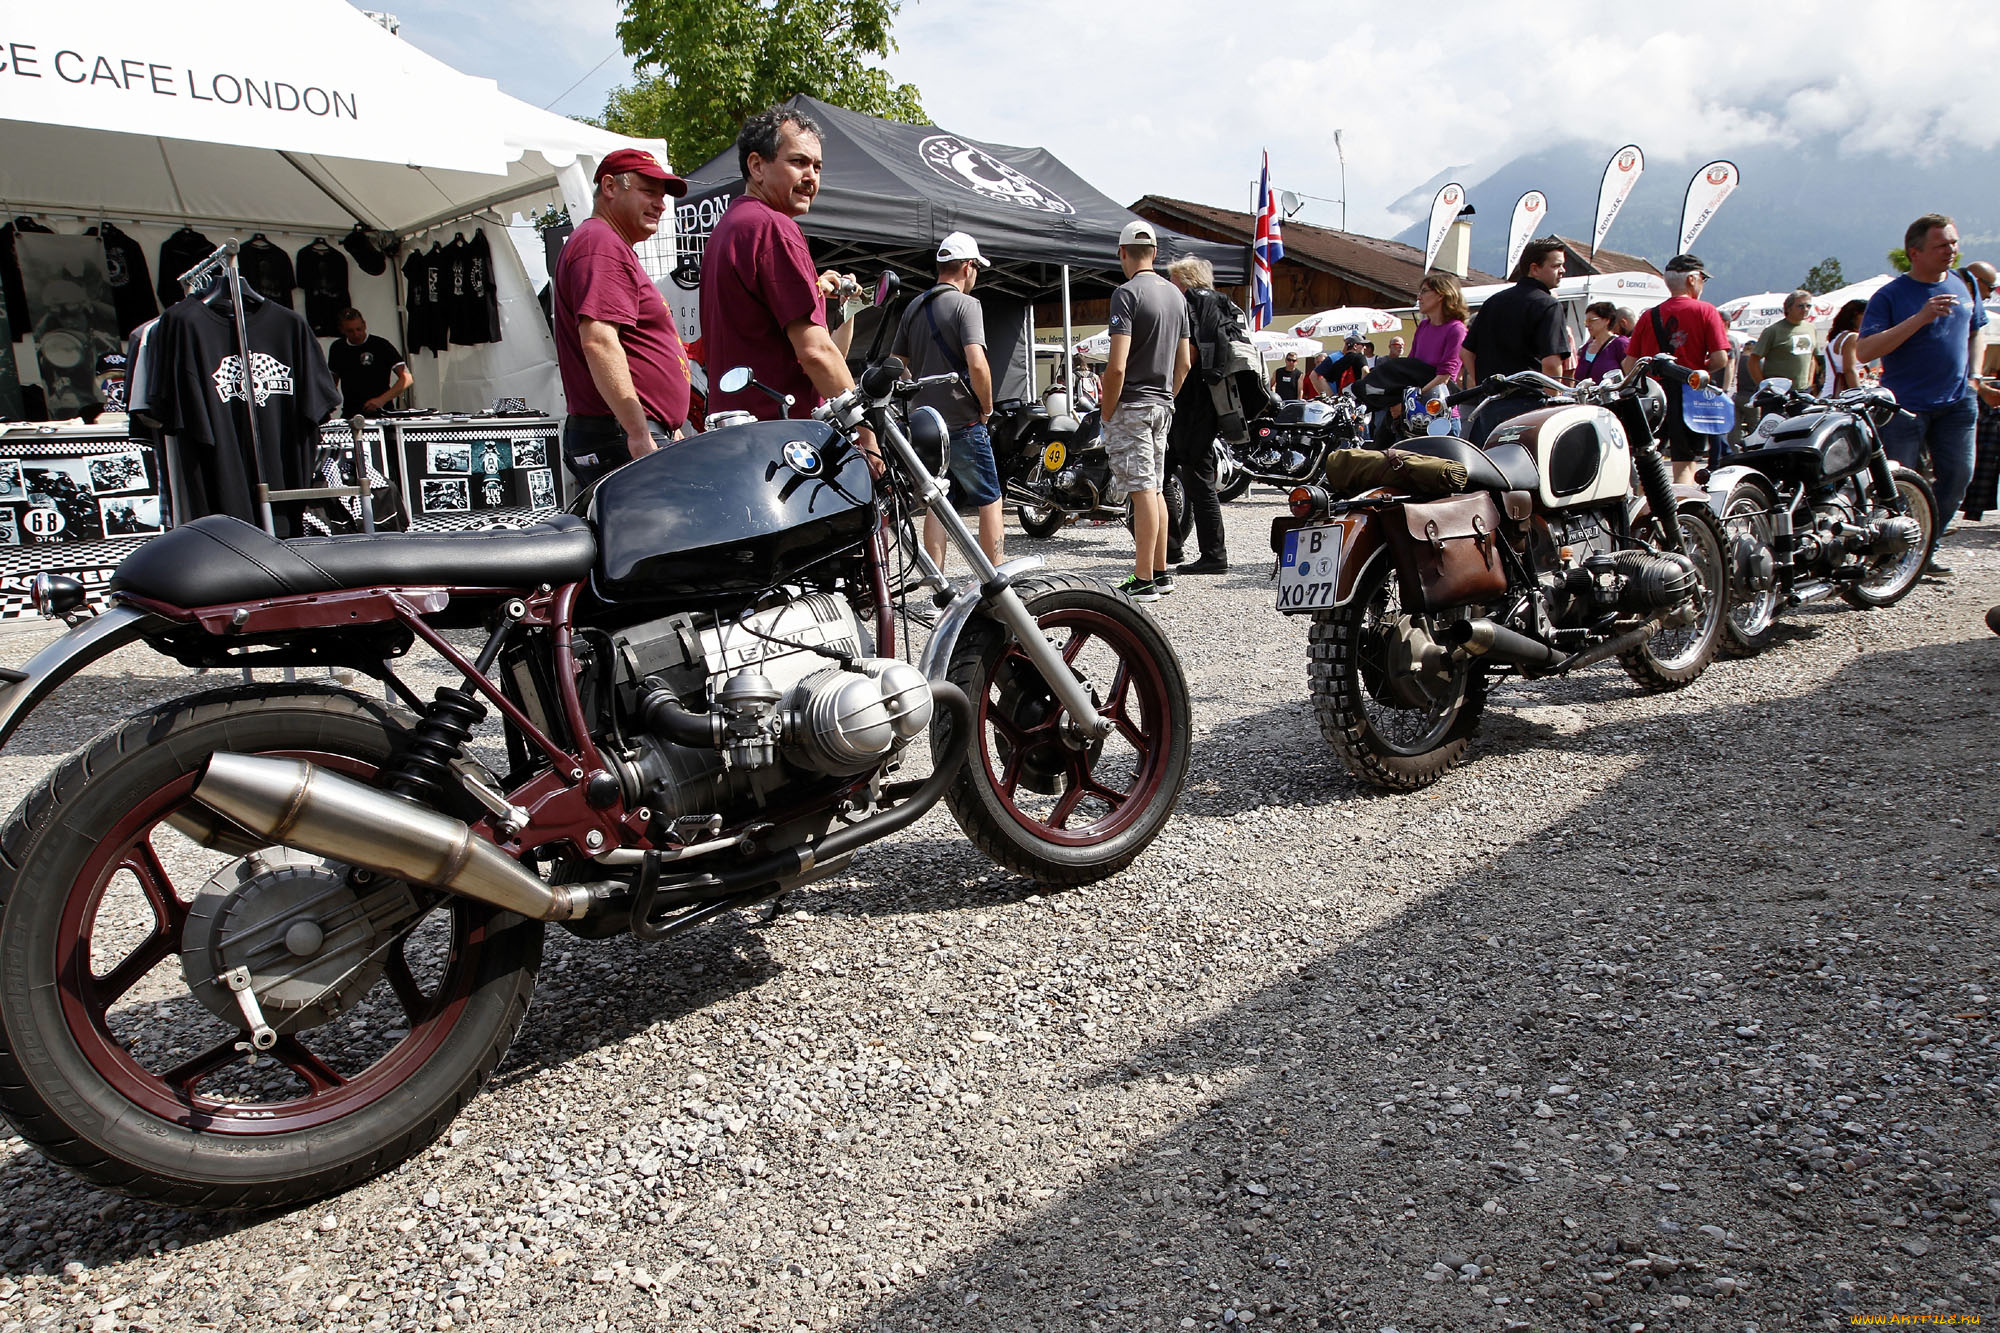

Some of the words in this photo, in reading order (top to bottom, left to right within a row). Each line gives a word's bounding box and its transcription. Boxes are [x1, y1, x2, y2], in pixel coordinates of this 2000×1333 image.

[54, 49, 177, 96] CAFE
[187, 68, 358, 120] LONDON
[1598, 197, 1622, 236] ERDINGER
[1683, 208, 1712, 245] ERDINGER
[1760, 307, 1785, 316] ERDIN
[1328, 323, 1360, 333] ERDINGER
[1048, 449, 1061, 463] 49
[32, 512, 57, 532] 68
[1310, 531, 1322, 553] B
